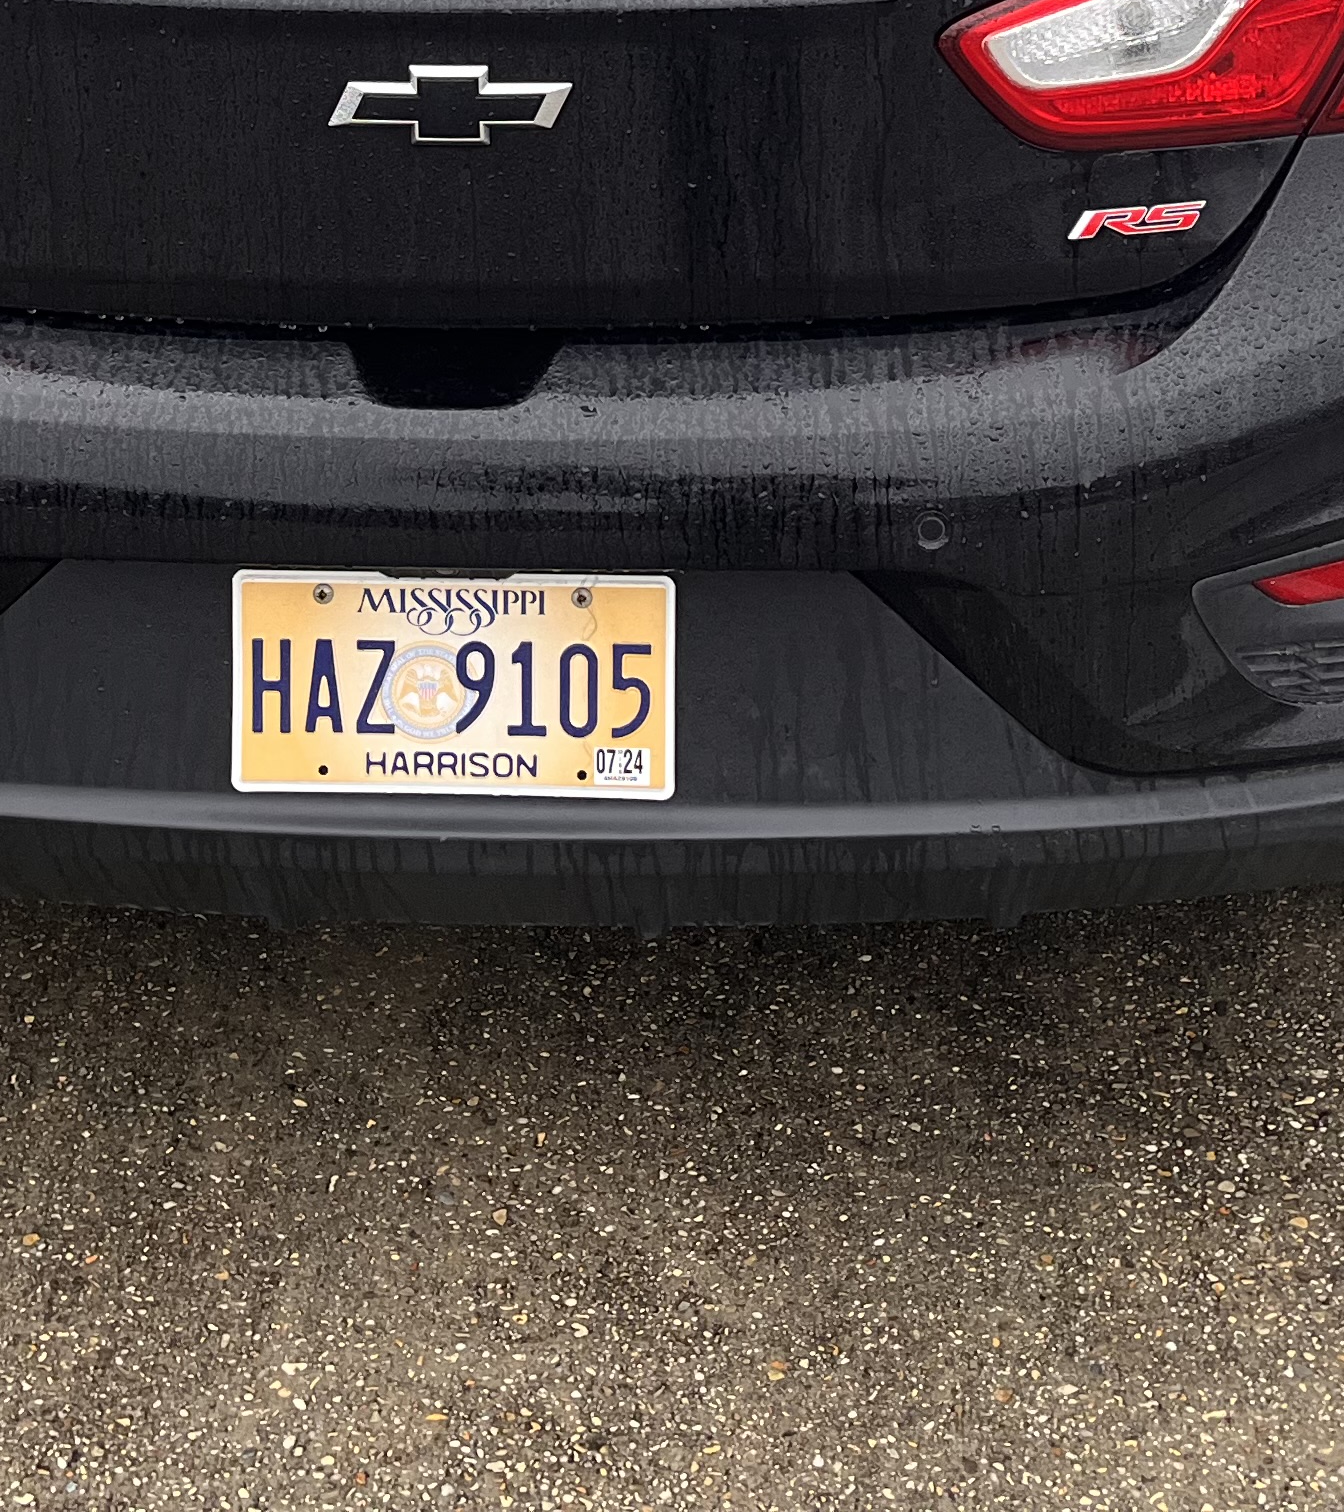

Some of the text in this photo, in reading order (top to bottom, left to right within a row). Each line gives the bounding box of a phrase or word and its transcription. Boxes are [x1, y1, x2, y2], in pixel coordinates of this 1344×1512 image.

[1067, 200, 1207, 240] RS
[357, 588, 546, 636] MISSISSIPPI
[251, 638, 652, 739] HAZ 9105
[366, 751, 537, 779] HARRISON
[596, 748, 616, 774] 07
[623, 748, 643, 775] 24
